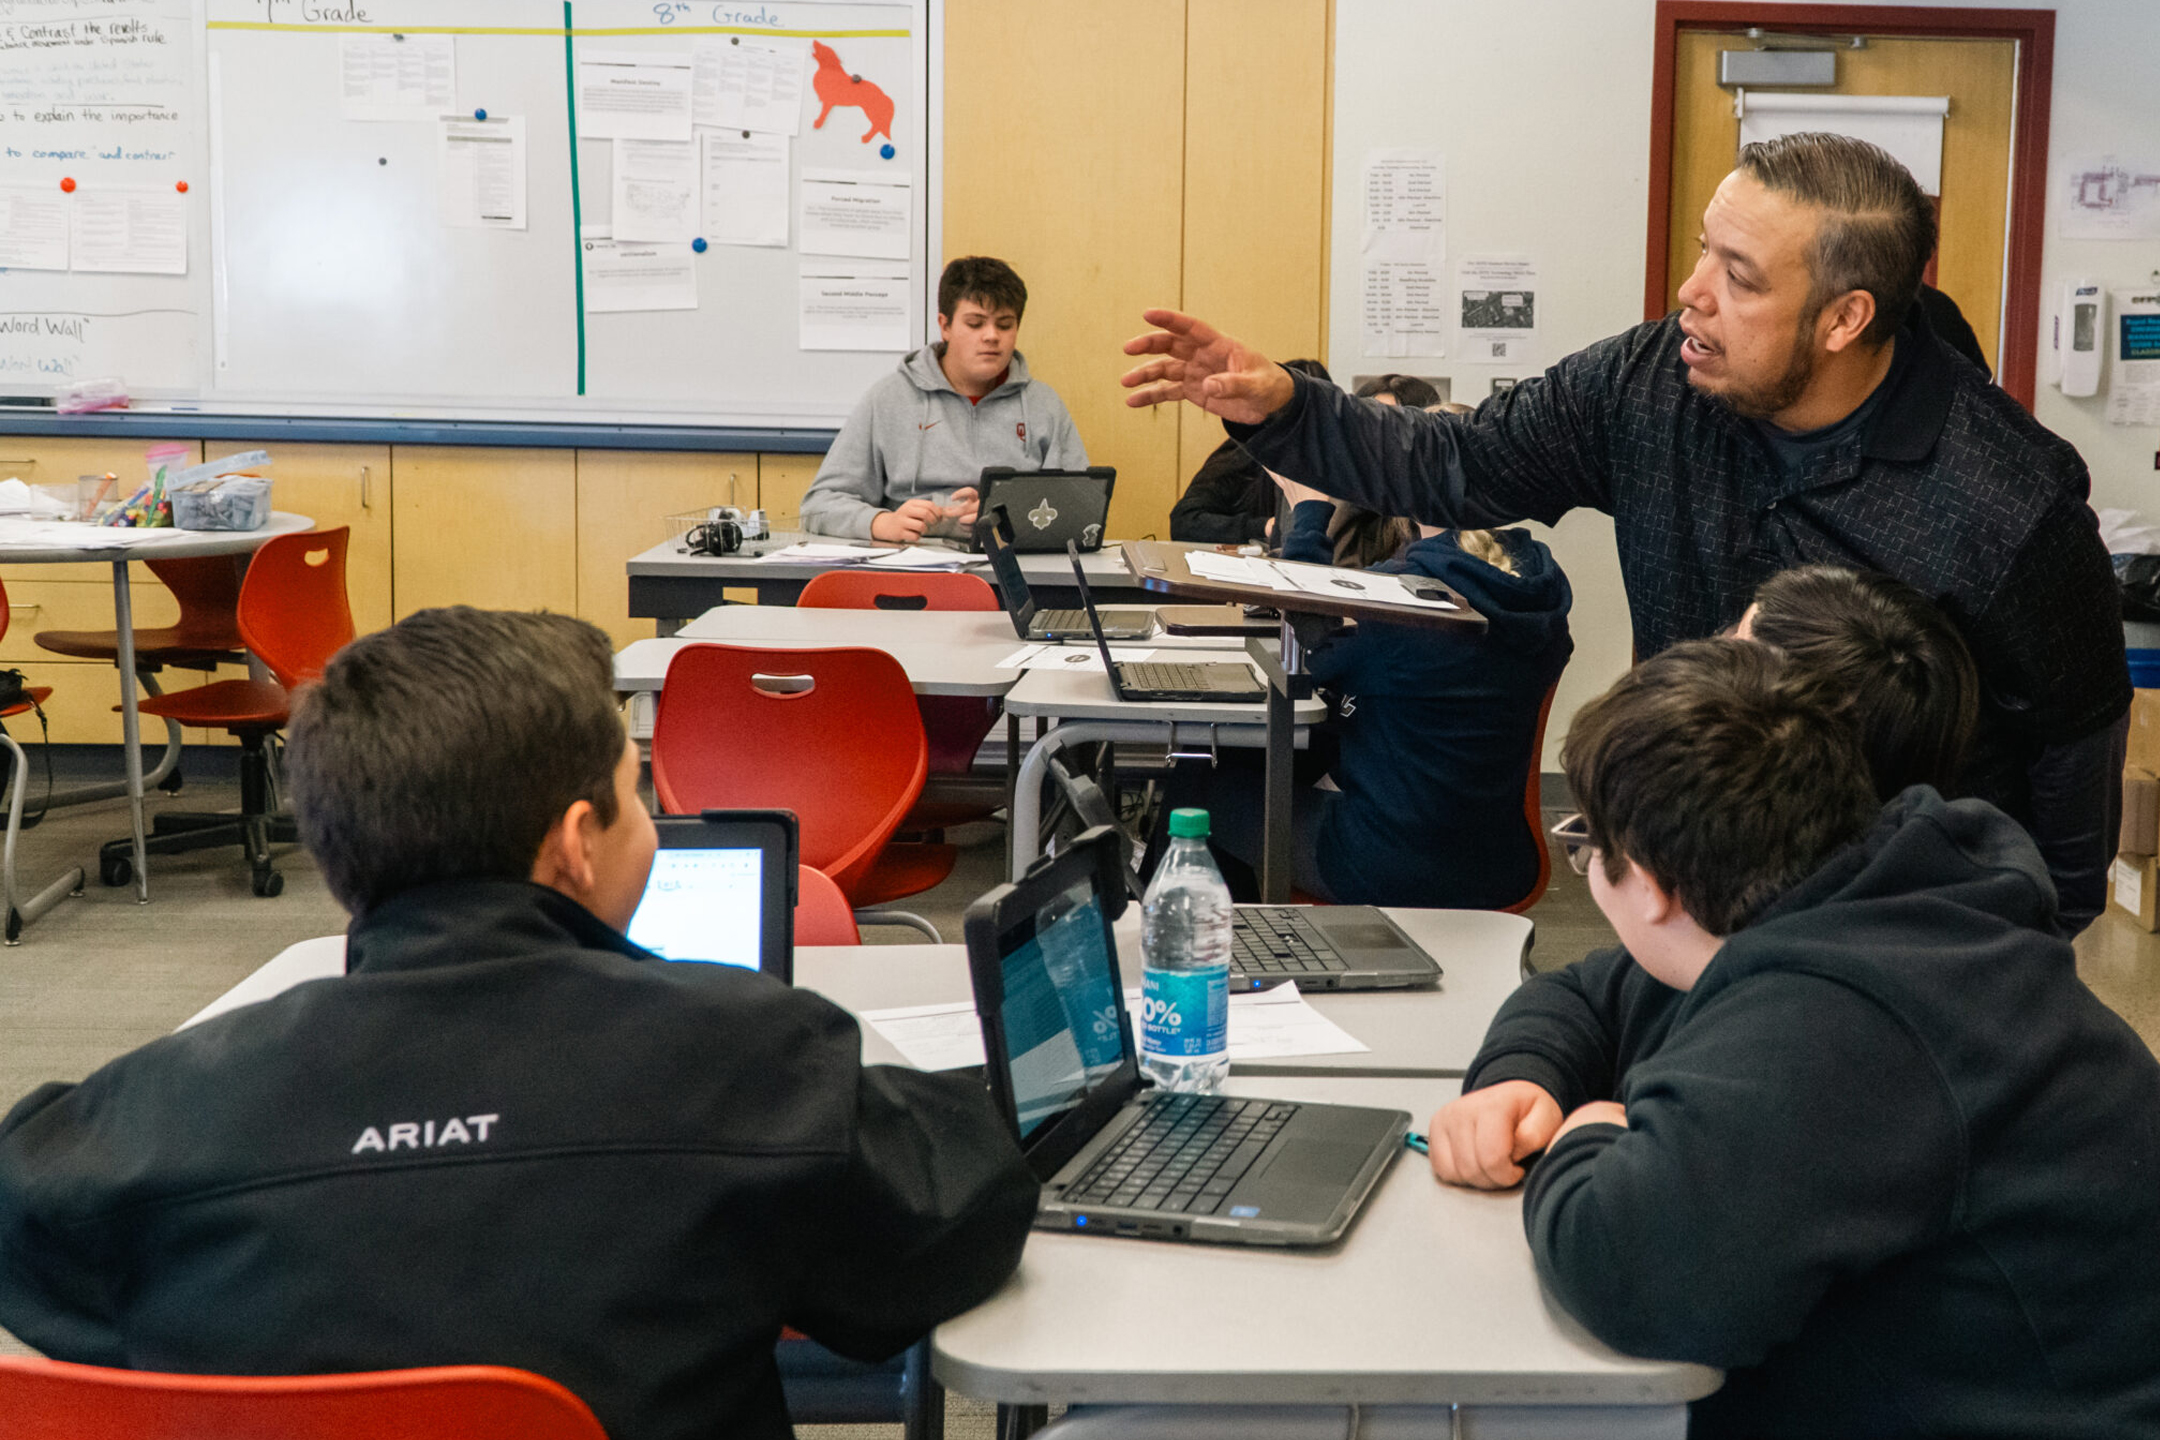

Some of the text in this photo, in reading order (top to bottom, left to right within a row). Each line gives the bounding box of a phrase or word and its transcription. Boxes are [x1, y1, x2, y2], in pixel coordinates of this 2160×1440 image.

[301, 0, 374, 23] Grade
[652, 2, 785, 29] 8th Grade
[20, 24, 76, 40] Contrast
[84, 20, 102, 36] the
[142, 29, 168, 45] rule
[13, 107, 178, 124] to explain the importance
[6, 146, 176, 162] to compare and contrast
[351, 1113, 500, 1155] ARIAT
